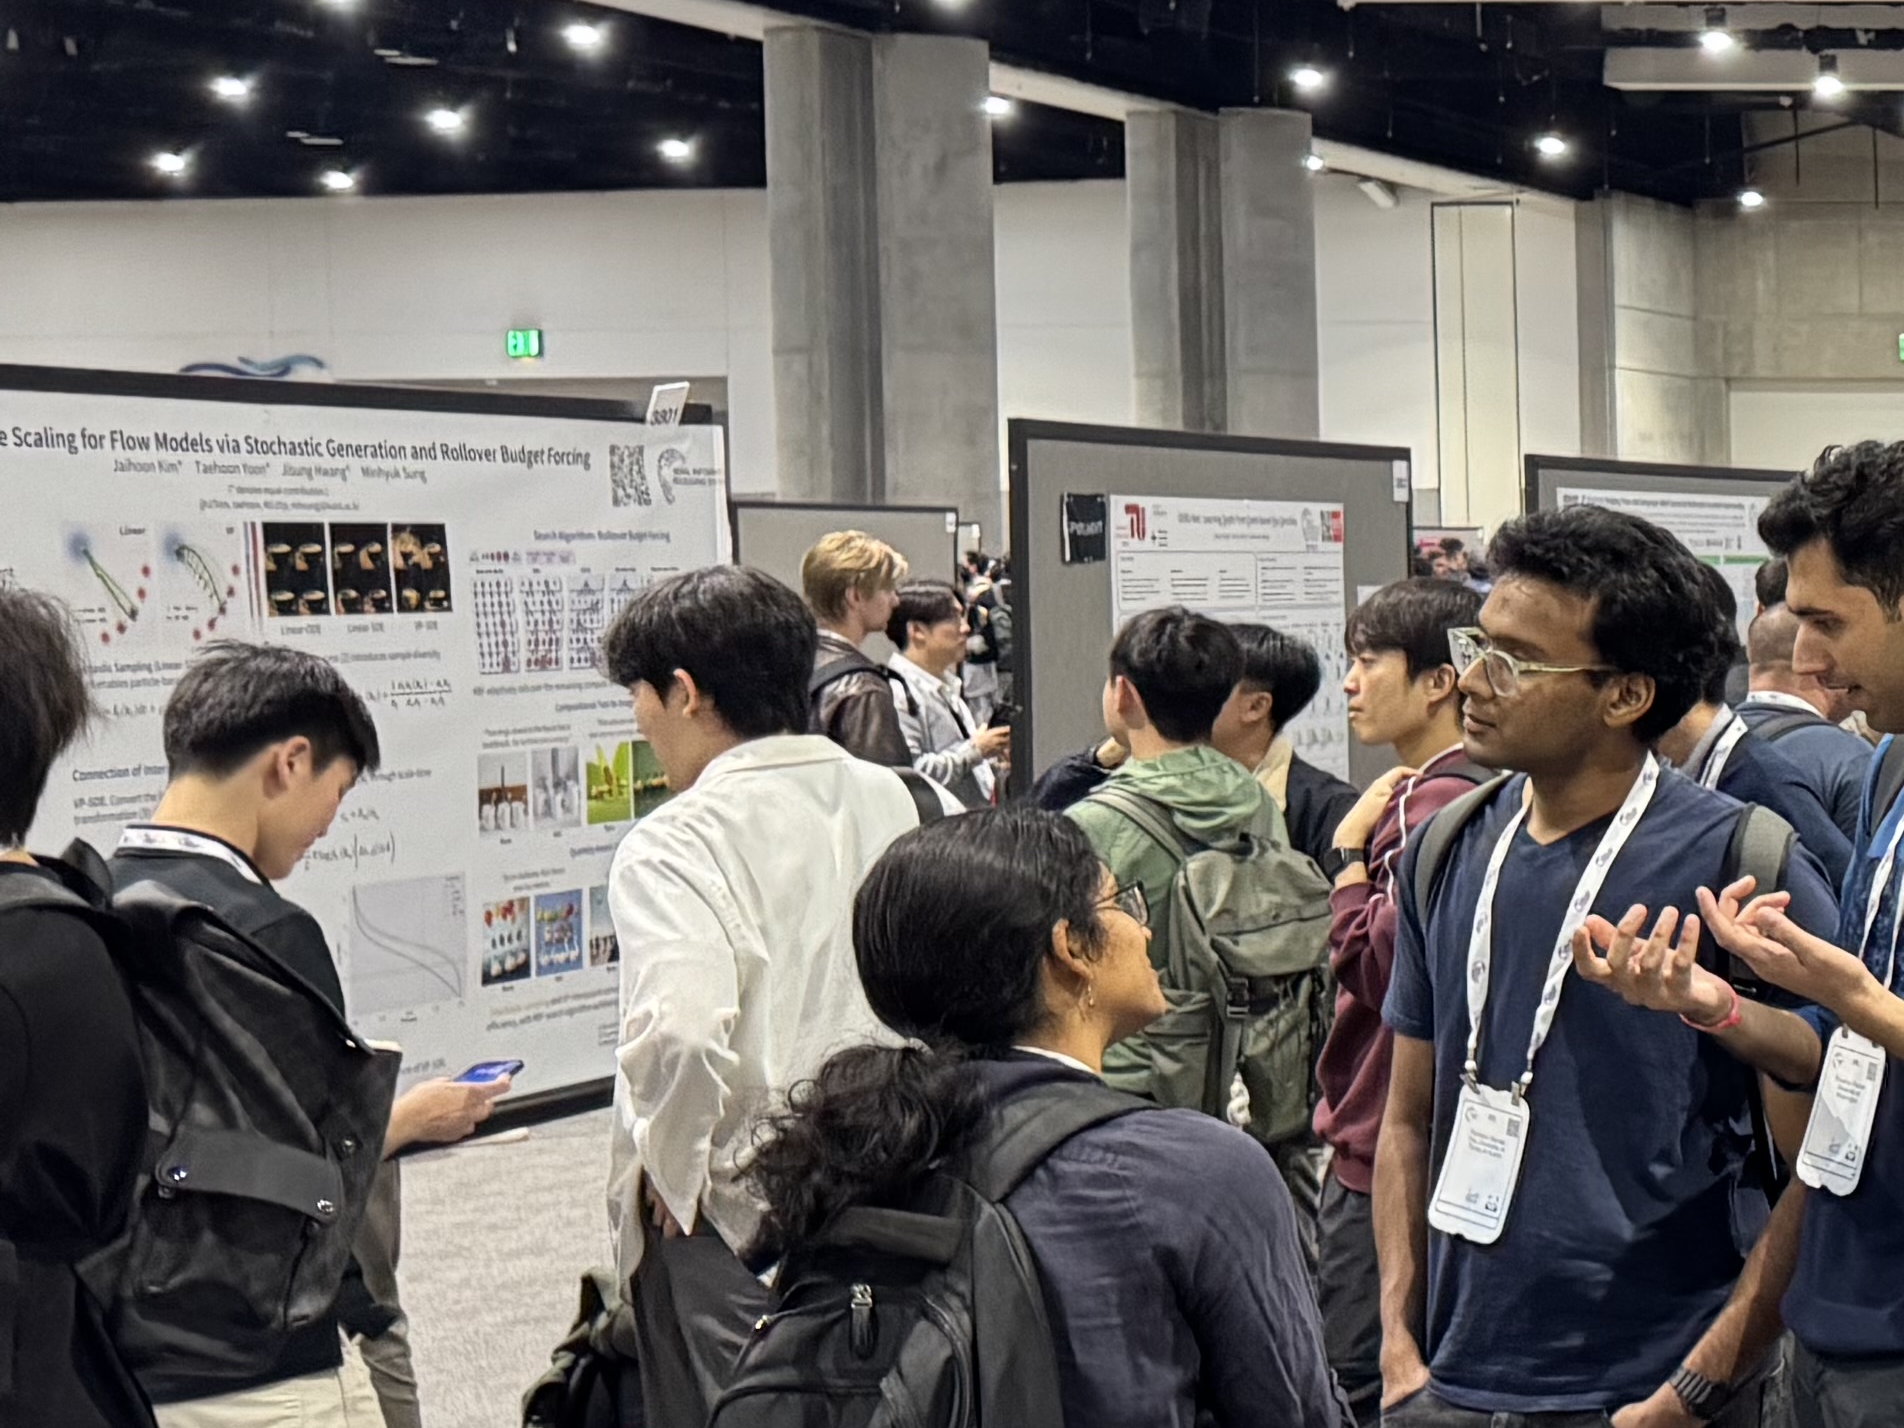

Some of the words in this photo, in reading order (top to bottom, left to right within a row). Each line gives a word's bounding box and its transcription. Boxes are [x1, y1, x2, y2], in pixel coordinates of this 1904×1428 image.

[12, 427, 78, 454] Scaling
[81, 428, 105, 450] for
[110, 430, 150, 451] Flow
[154, 431, 213, 454] Models
[216, 434, 241, 454] via
[245, 435, 323, 457] Stochastic
[326, 438, 406, 460] Generation
[410, 441, 437, 460] and
[440, 443, 497, 462] Rollover
[500, 445, 545, 469] Budget
[547, 447, 592, 471] Forcing
